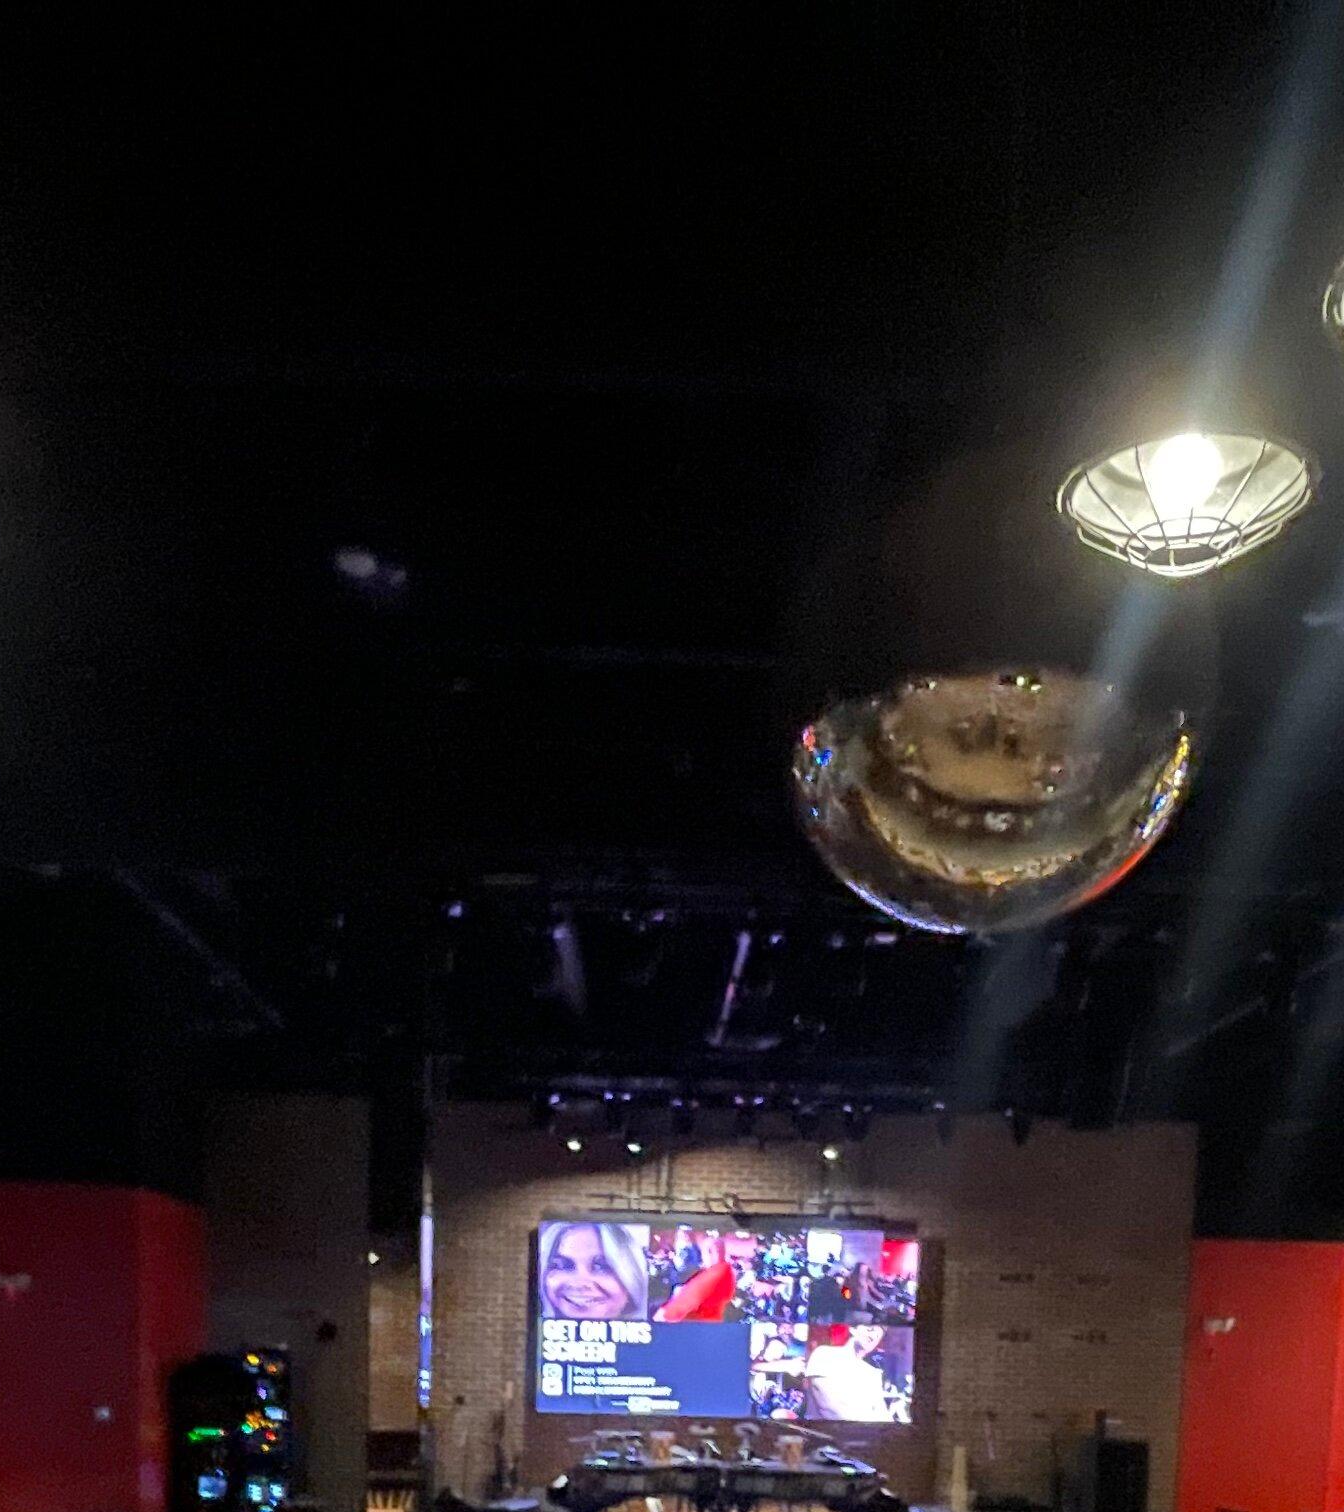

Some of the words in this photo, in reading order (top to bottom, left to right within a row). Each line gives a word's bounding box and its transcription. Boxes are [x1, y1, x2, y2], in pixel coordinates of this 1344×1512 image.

[543, 1320, 578, 1341] GET
[580, 1321, 607, 1341] ON
[609, 1321, 652, 1343] THIS
